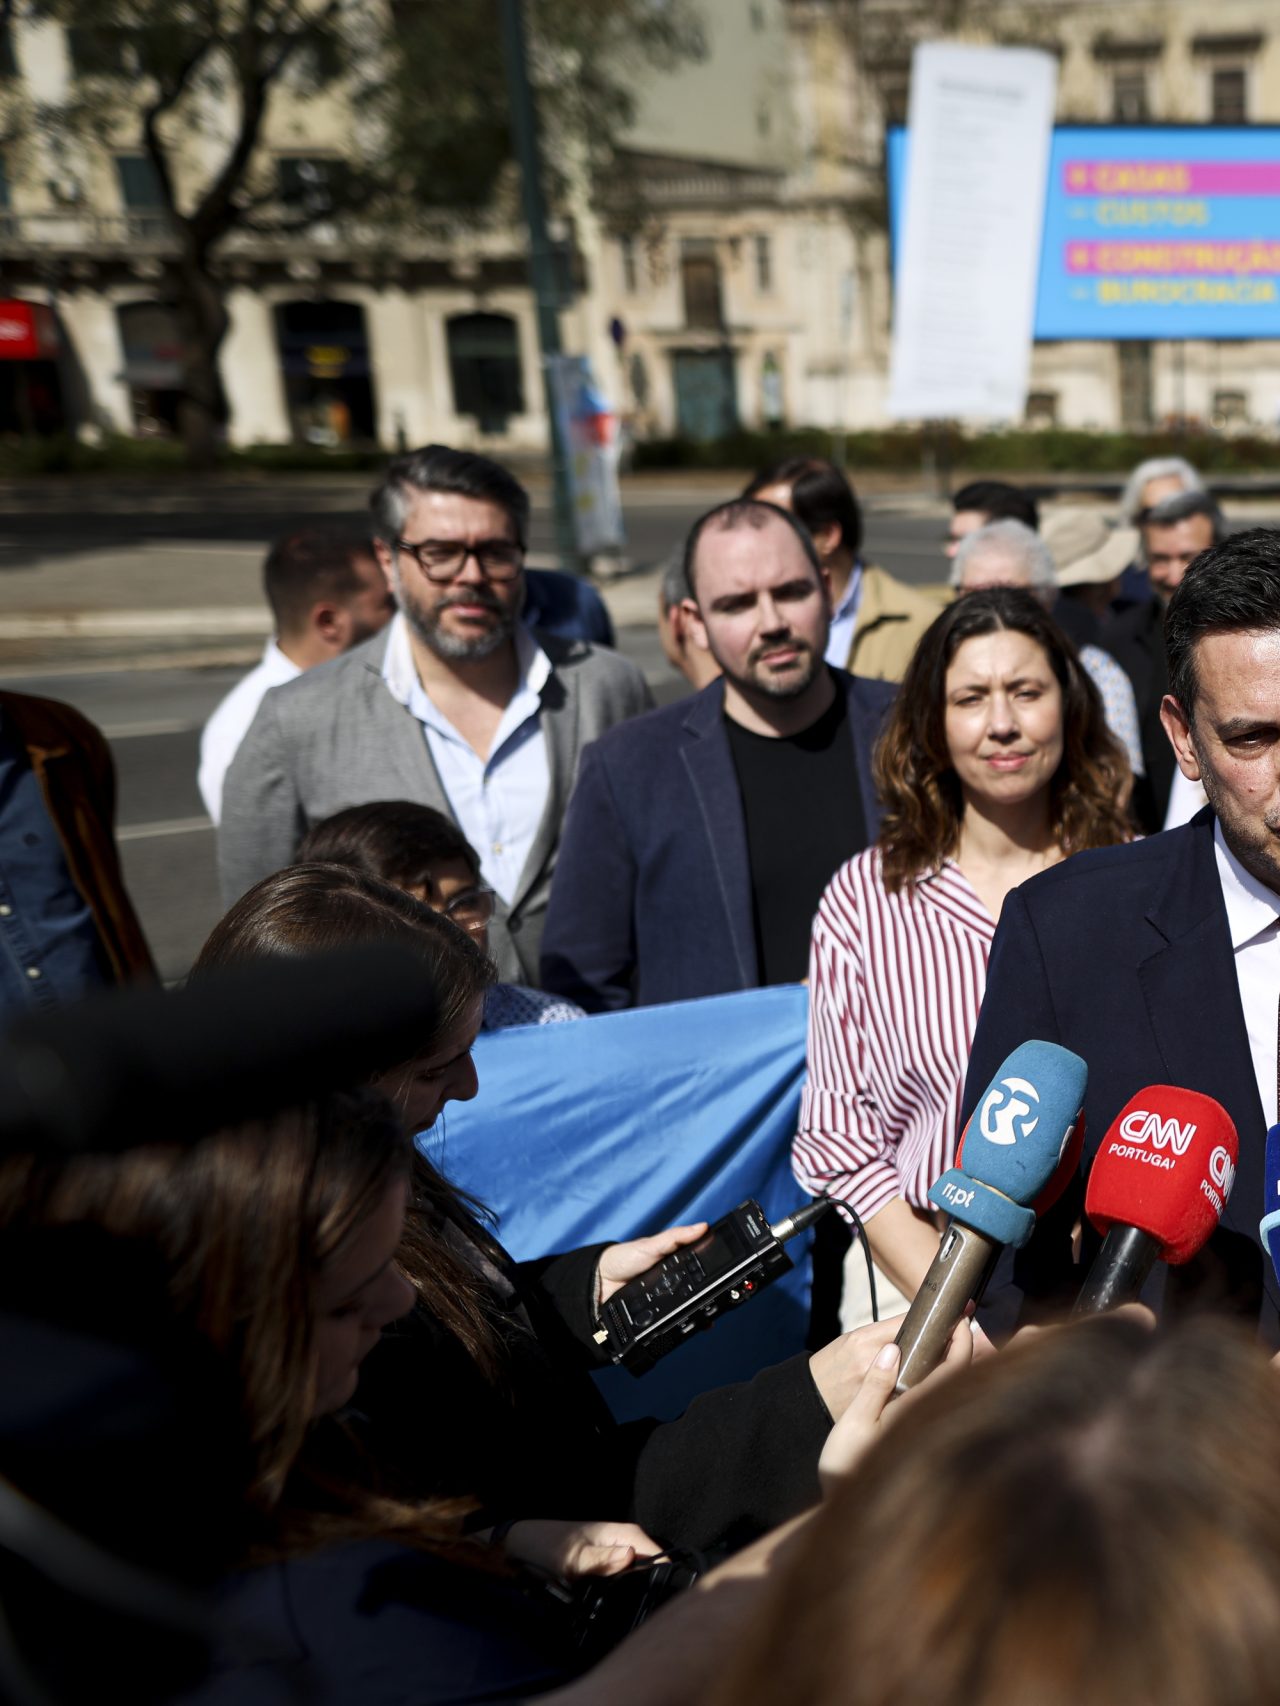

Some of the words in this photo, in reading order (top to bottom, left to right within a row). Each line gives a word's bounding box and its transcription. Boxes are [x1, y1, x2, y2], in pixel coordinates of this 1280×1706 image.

[1097, 201, 1208, 226] CUSTOS
[1098, 279, 1277, 304] BUROCRACIA
[1120, 1110, 1198, 1156] CNN
[941, 1182, 975, 1208] rr.pt
